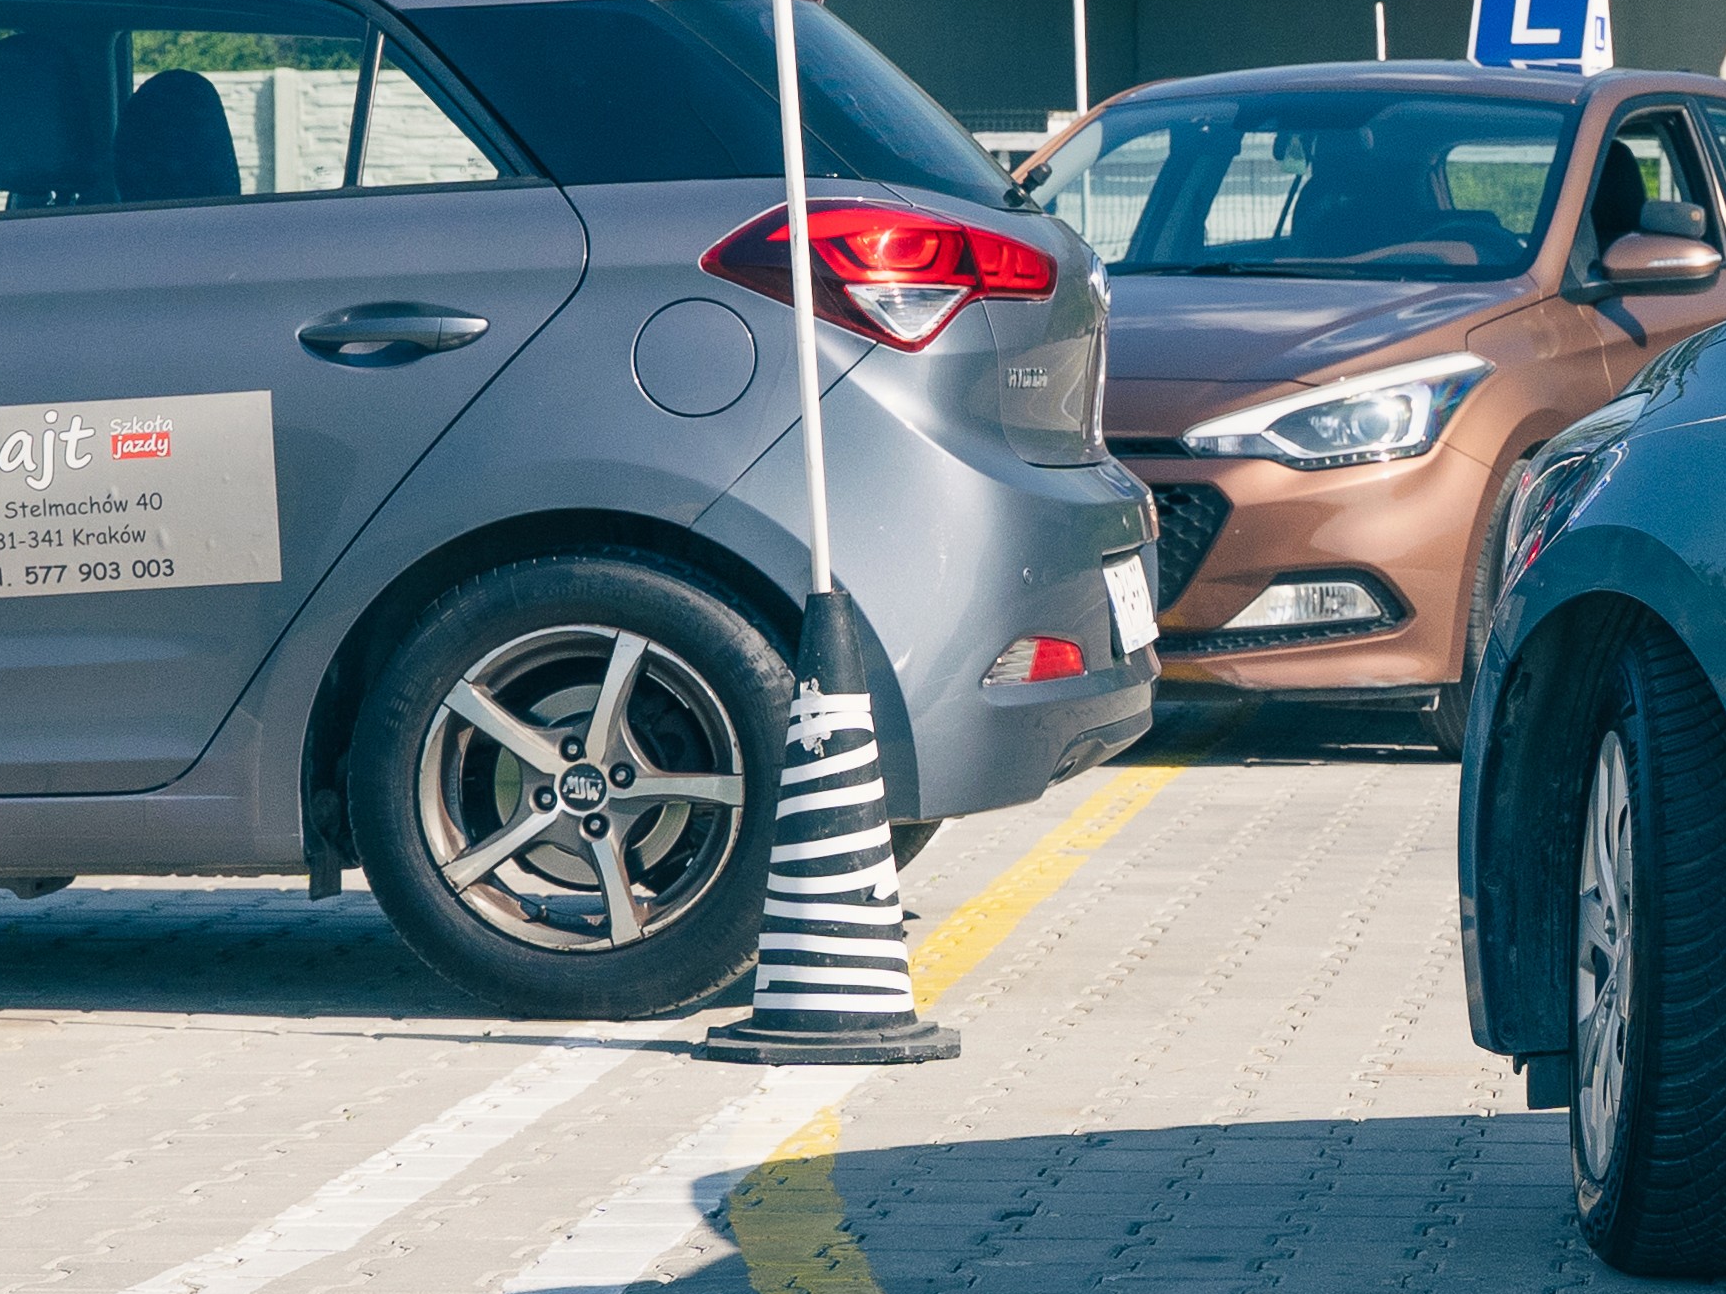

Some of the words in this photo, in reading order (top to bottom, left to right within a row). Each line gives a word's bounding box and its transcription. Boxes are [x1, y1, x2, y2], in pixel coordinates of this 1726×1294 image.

[109, 414, 174, 436] Szkoła
[112, 433, 170, 459] jazdy
[4, 492, 128, 520] Stelmachów
[136, 492, 163, 511] 40
[73, 523, 146, 547] Kraków
[25, 564, 67, 585] 577
[78, 561, 121, 583] 903
[132, 558, 175, 579] 003
